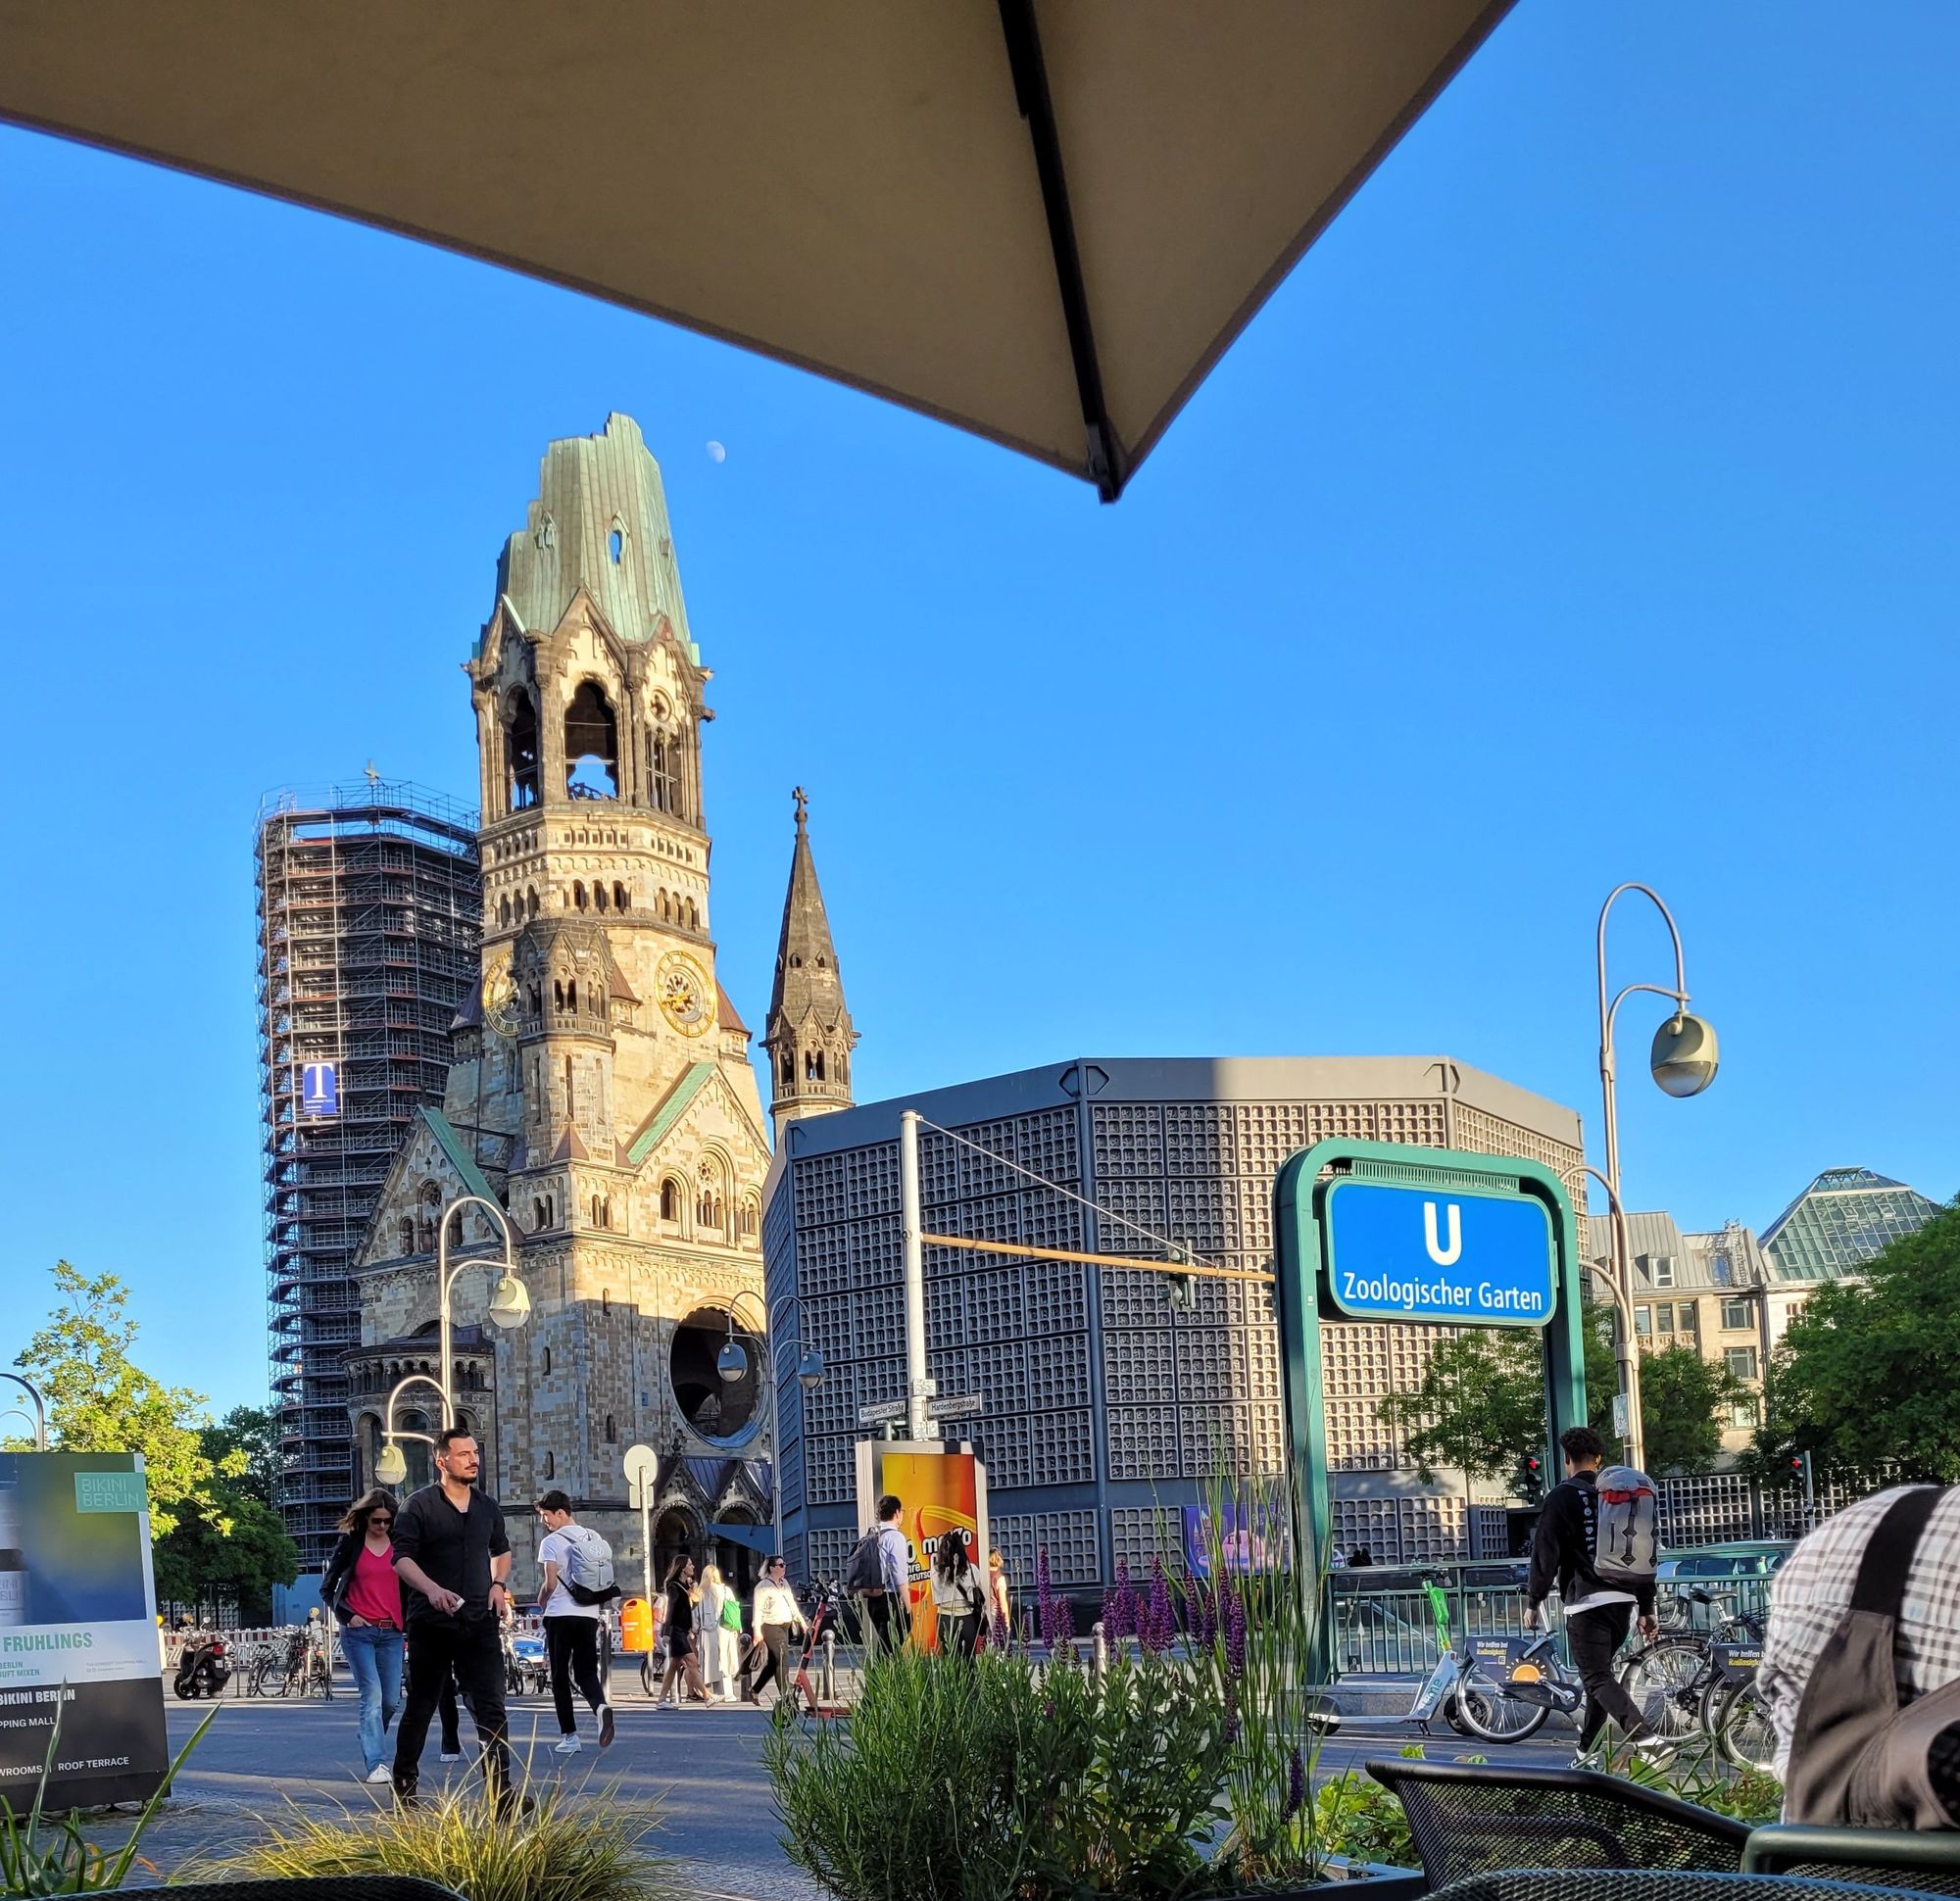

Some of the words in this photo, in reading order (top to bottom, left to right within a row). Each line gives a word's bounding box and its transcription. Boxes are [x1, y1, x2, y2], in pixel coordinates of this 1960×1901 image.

[305, 1062, 333, 1098] T
[1423, 1201, 1462, 1266] U
[1343, 1272, 1472, 1310] Zoologischer
[1478, 1282, 1542, 1311] Garten
[932, 1398, 975, 1411] Hardenbergstraße
[81, 1478, 126, 1492] BIKINI
[83, 1492, 139, 1507] BERLIN
[28, 1717, 55, 1727] MALL
[58, 1761, 85, 1772] ROOF
[86, 1756, 129, 1769] TERRACE
